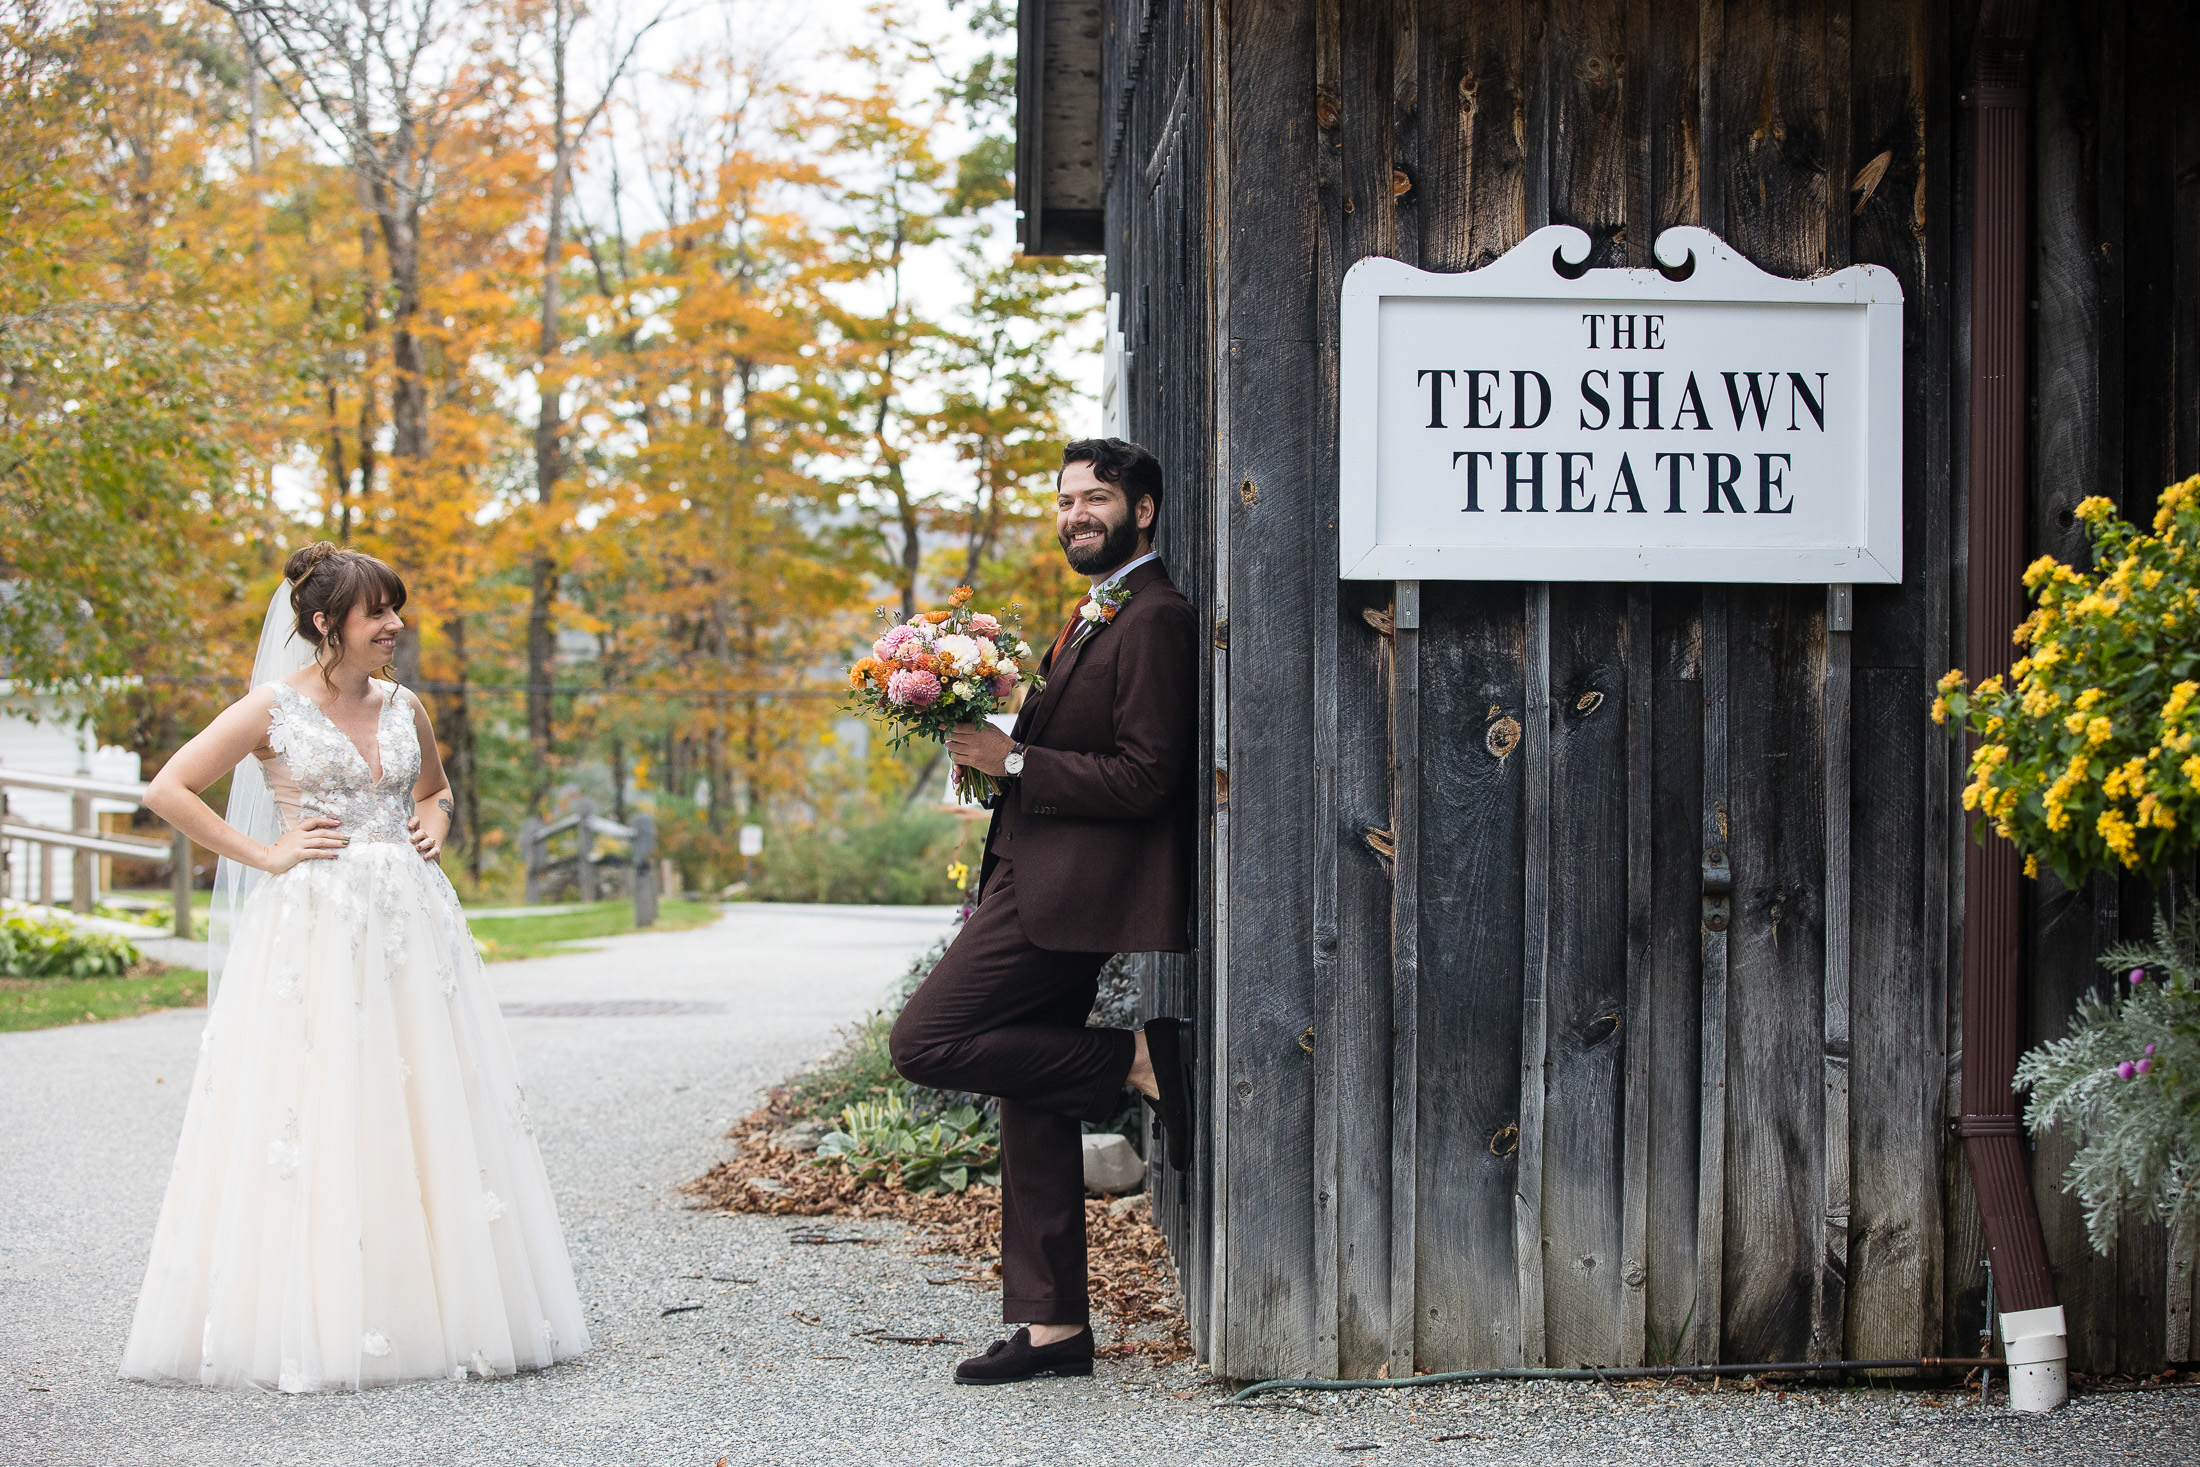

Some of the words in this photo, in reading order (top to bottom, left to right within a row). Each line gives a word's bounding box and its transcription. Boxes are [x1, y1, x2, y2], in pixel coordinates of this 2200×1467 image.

[1582, 314, 1666, 350] THE
[1417, 369, 1552, 429] TED
[1580, 369, 1829, 433] SHAWN
[1452, 451, 1794, 514] THEATRE
